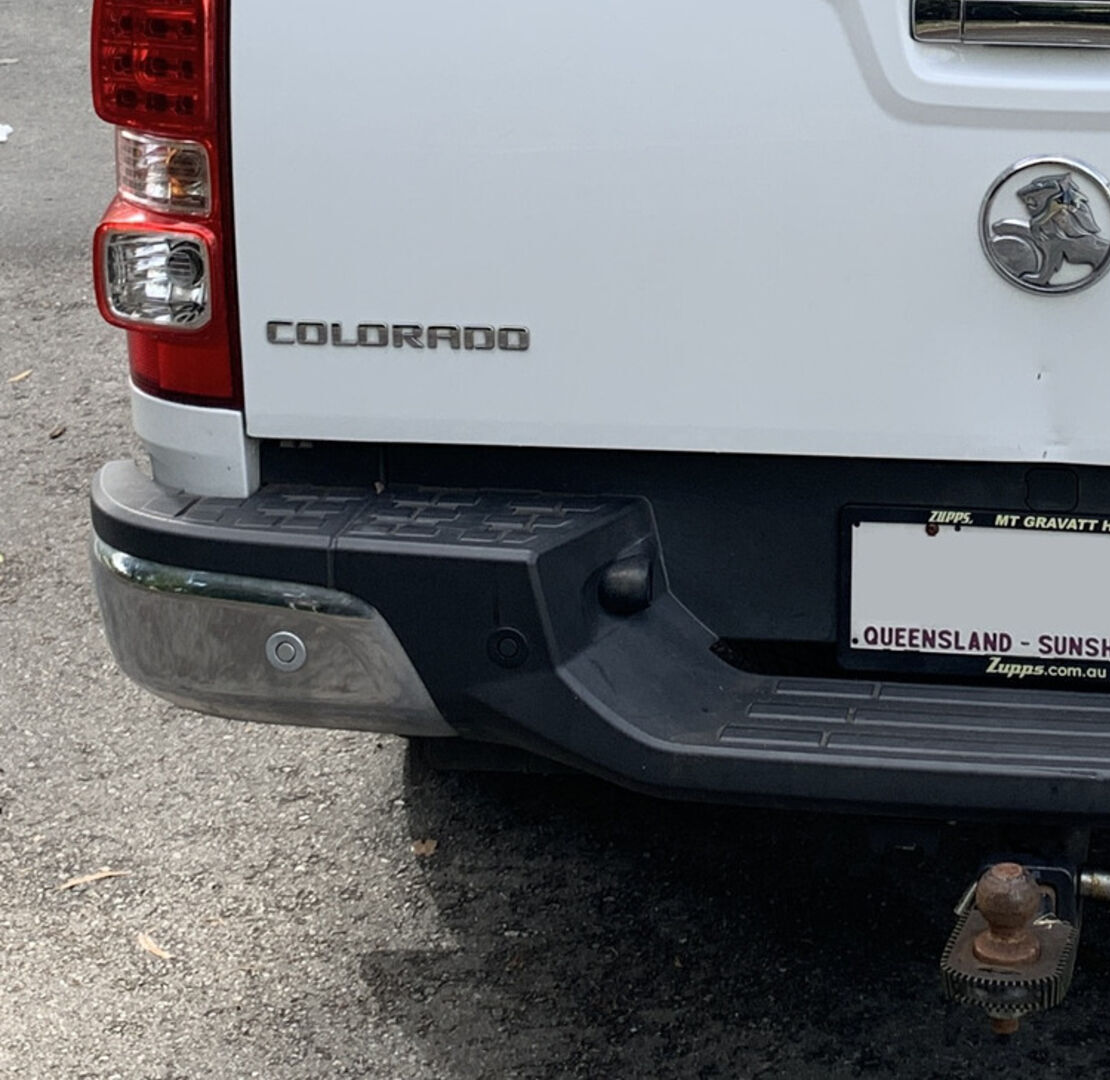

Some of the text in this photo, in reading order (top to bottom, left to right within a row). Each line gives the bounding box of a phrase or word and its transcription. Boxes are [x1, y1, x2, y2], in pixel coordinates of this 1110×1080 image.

[266, 321, 531, 352] COLORADO
[995, 514, 1020, 528] MT
[1023, 516, 1099, 531] GRAVATT
[864, 626, 1013, 653] QUEENSLAND
[985, 657, 1107, 679] Zupps.com.au
